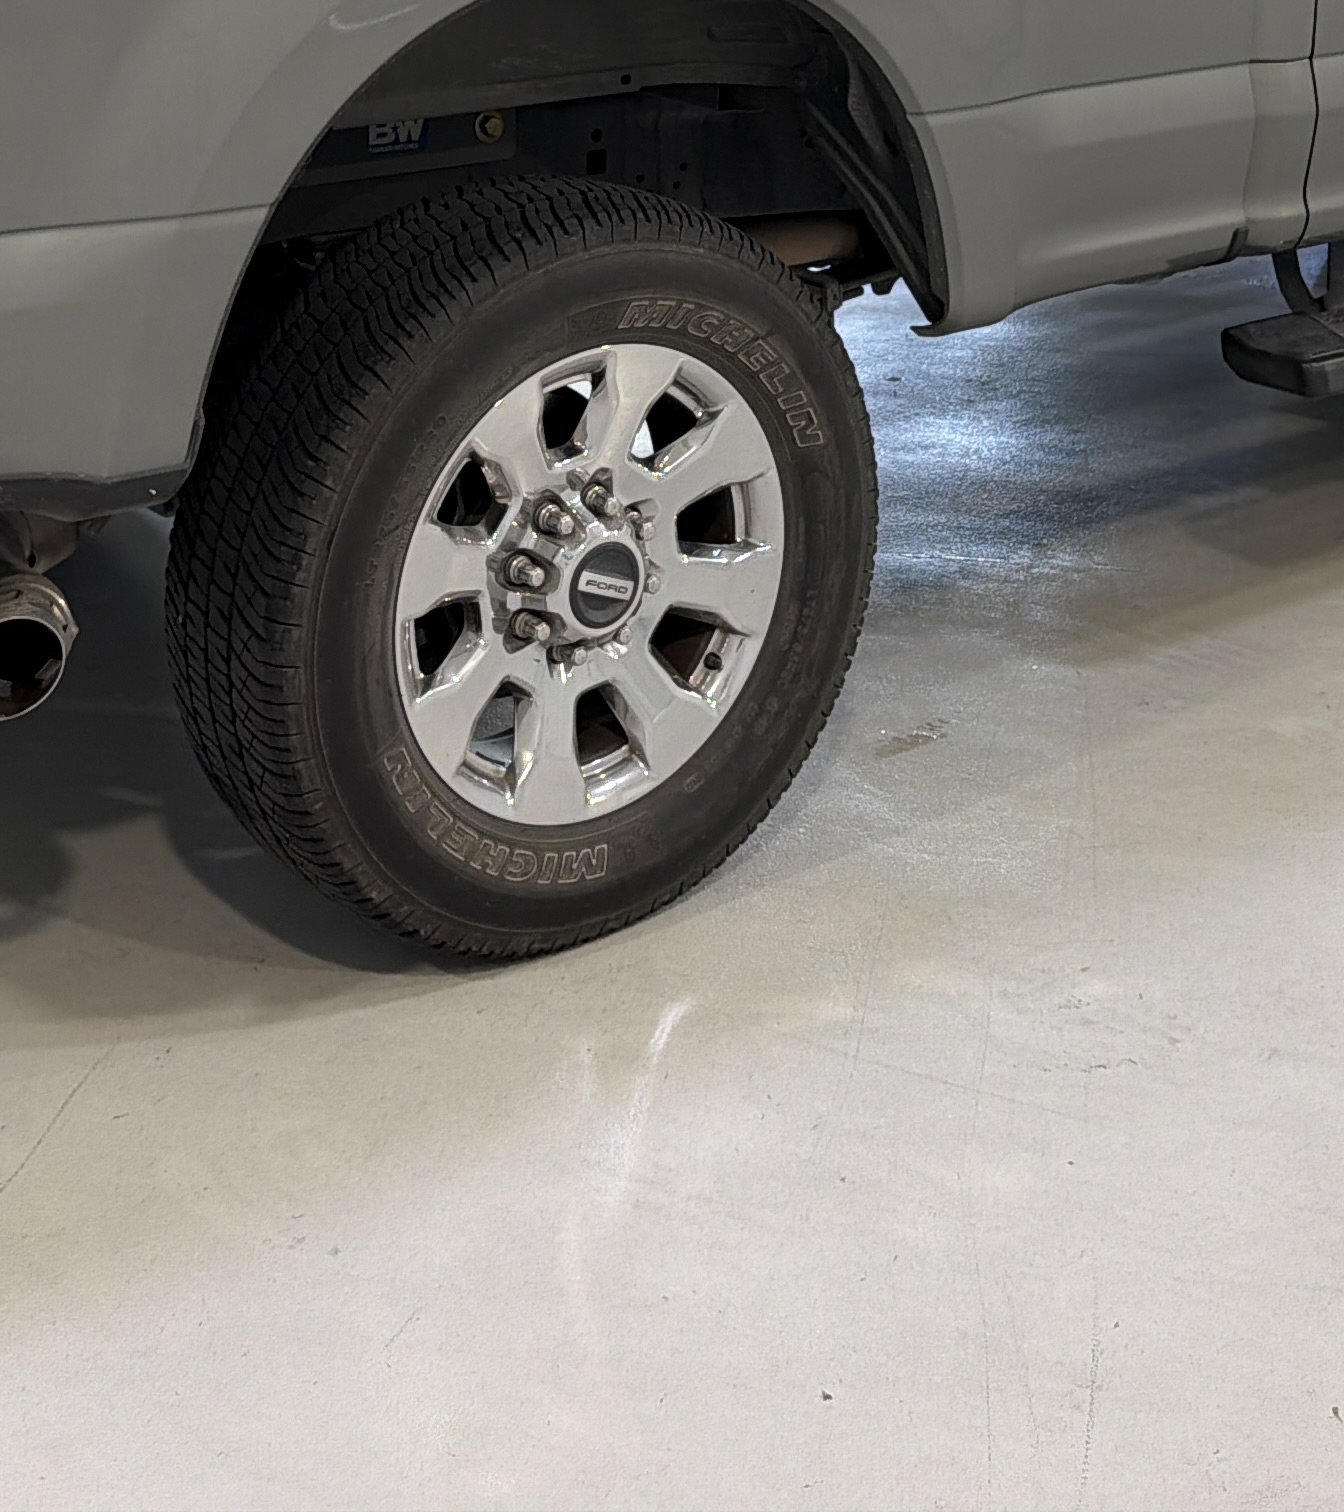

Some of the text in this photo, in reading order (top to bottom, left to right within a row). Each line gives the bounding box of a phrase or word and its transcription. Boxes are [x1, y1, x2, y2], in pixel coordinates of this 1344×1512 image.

[617, 299, 824, 448] MICHELIN
[585, 579, 628, 595] FORD
[383, 746, 608, 885] MICHELIN
